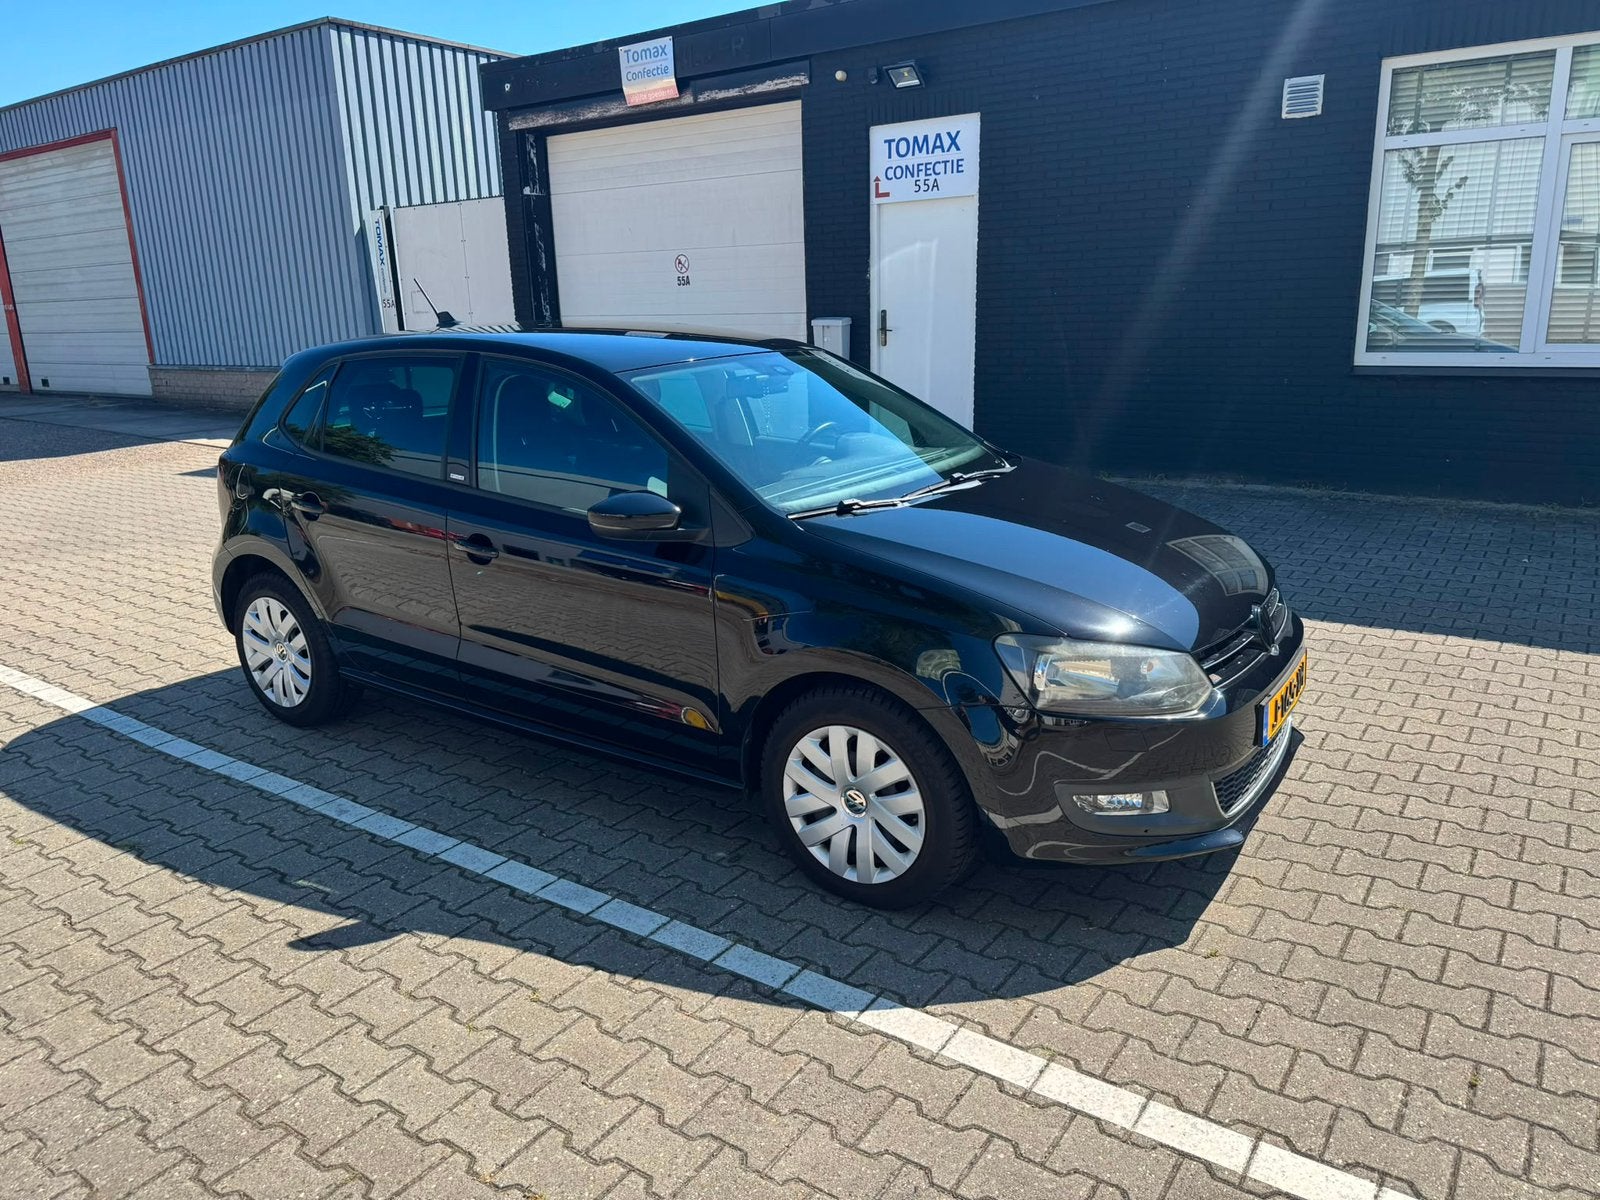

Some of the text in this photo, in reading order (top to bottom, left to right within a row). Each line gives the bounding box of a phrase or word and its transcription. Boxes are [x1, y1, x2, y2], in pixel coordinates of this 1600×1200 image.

[624, 44, 668, 64] Tomax
[626, 64, 669, 81] Confectie
[884, 130, 961, 159] TOMAX
[885, 158, 965, 180] CONFECTIE
[914, 178, 940, 193] 55A
[375, 219, 386, 266] TOMAX
[677, 275, 690, 286] 55A
[382, 299, 395, 308] 55A
